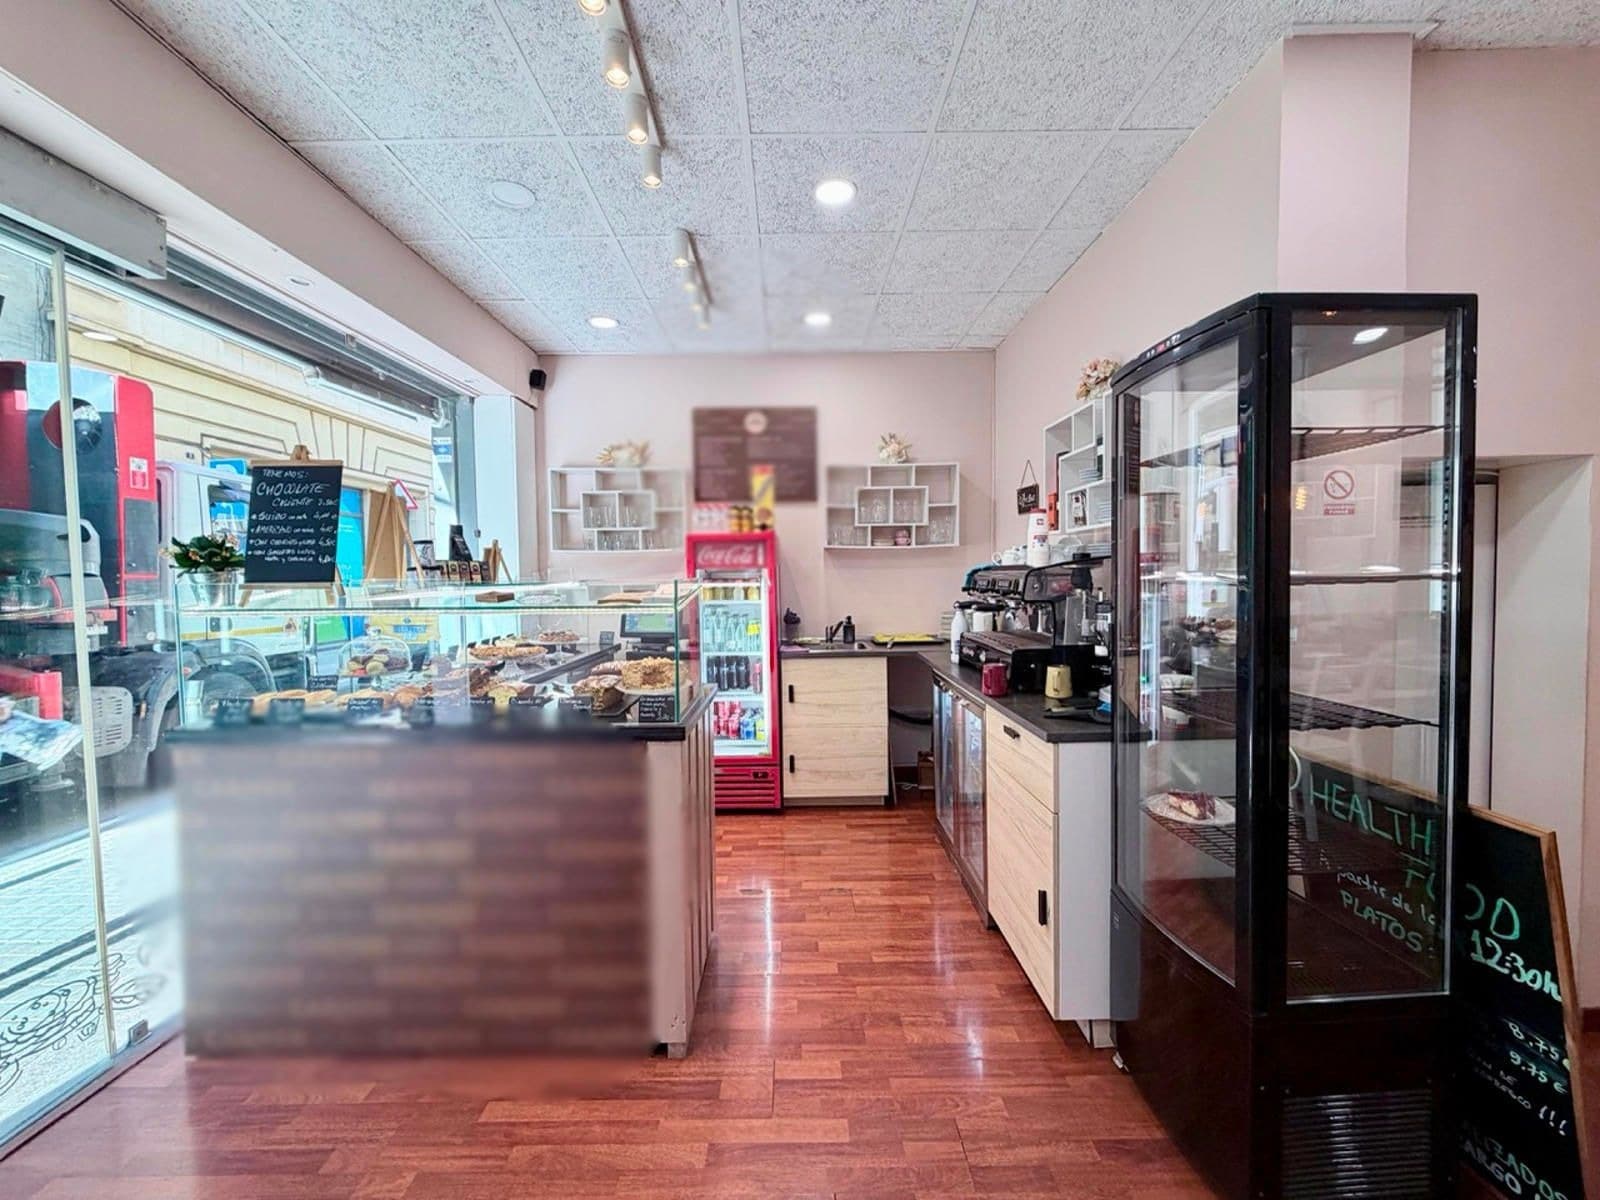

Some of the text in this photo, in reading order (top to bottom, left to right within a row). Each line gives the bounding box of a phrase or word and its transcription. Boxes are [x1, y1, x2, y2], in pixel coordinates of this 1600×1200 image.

[256, 481, 330, 497] CHOCOLATE
[1310, 772, 1437, 856] HEALTH
[1470, 929, 1563, 1003] 12:30h
